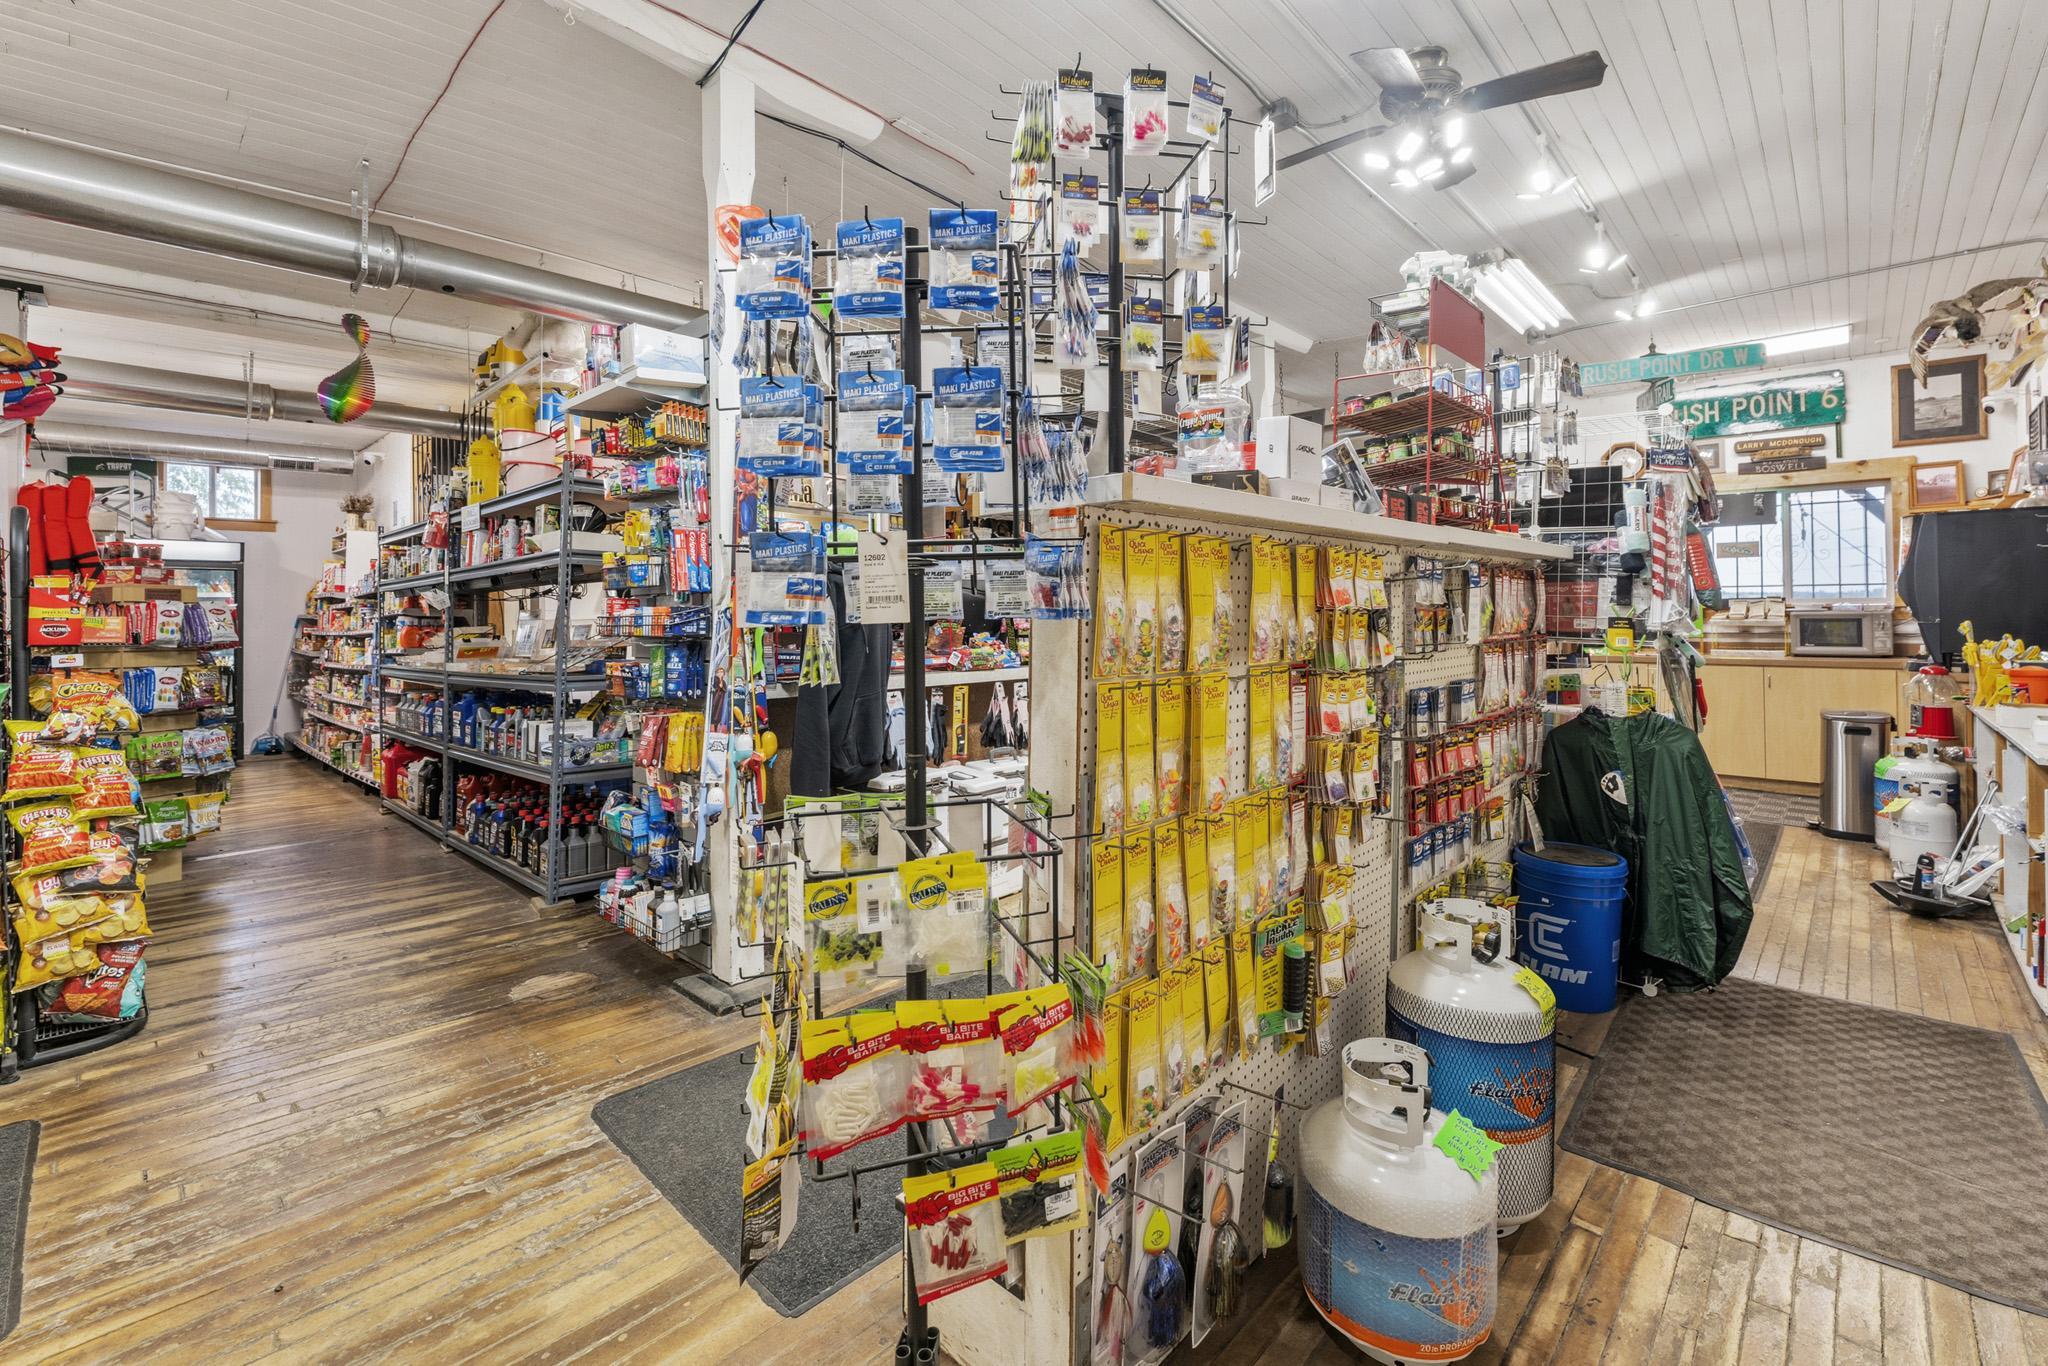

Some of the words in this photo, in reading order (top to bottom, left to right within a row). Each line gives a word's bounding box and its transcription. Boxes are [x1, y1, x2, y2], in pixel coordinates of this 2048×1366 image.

[745, 236, 763, 246] MAKI
[765, 228, 798, 242] PLASTICS
[842, 234, 861, 246] MAKI
[863, 229, 897, 244] PLASTICS
[935, 228, 954, 238] MAKI
[956, 224, 992, 236] PLASTICS
[1583, 361, 1635, 384] RUSH
[1640, 354, 1691, 379] POINT
[1701, 350, 1726, 370] DR
[1735, 347, 1749, 366] W
[844, 388, 862, 398] MAKI
[864, 383, 899, 395] PLASTICS
[940, 385, 958, 395] MAKI
[960, 380, 996, 392] PLASTICS
[1655, 384, 1674, 403] TRAIL
[1674, 401, 1720, 425] USH
[1732, 391, 1808, 420] POINT
[1822, 388, 1839, 409] 6
[1737, 441, 1765, 450] LARRY
[1769, 436, 1823, 448] MCDONOUGH
[1755, 462, 1808, 473] BOSWELL
[755, 550, 774, 558] MAKI
[775, 544, 807, 556] PLASTICS
[57, 682, 112, 697] Cheetos
[90, 834, 118, 848] Lay's
[38, 875, 61, 892] Lay
[909, 881, 948, 903] KALIN'S
[809, 891, 849, 914] KALIN'S
[1266, 916, 1299, 945] TACKLE
[1518, 951, 1591, 985] CLAM
[1049, 1003, 1068, 1018] BITE
[960, 1022, 984, 1032] BITE
[1040, 1012, 1065, 1030] BAITS
[867, 1033, 891, 1051] BITE
[946, 1030, 980, 1041] BAITS
[854, 1043, 886, 1060] BAITS
[999, 1167, 1025, 1182] ister
[1042, 1150, 1081, 1171] Twister
[948, 1189, 966, 1201] BIG
[968, 1181, 992, 1198] BITE
[954, 1190, 987, 1206] BAITS
